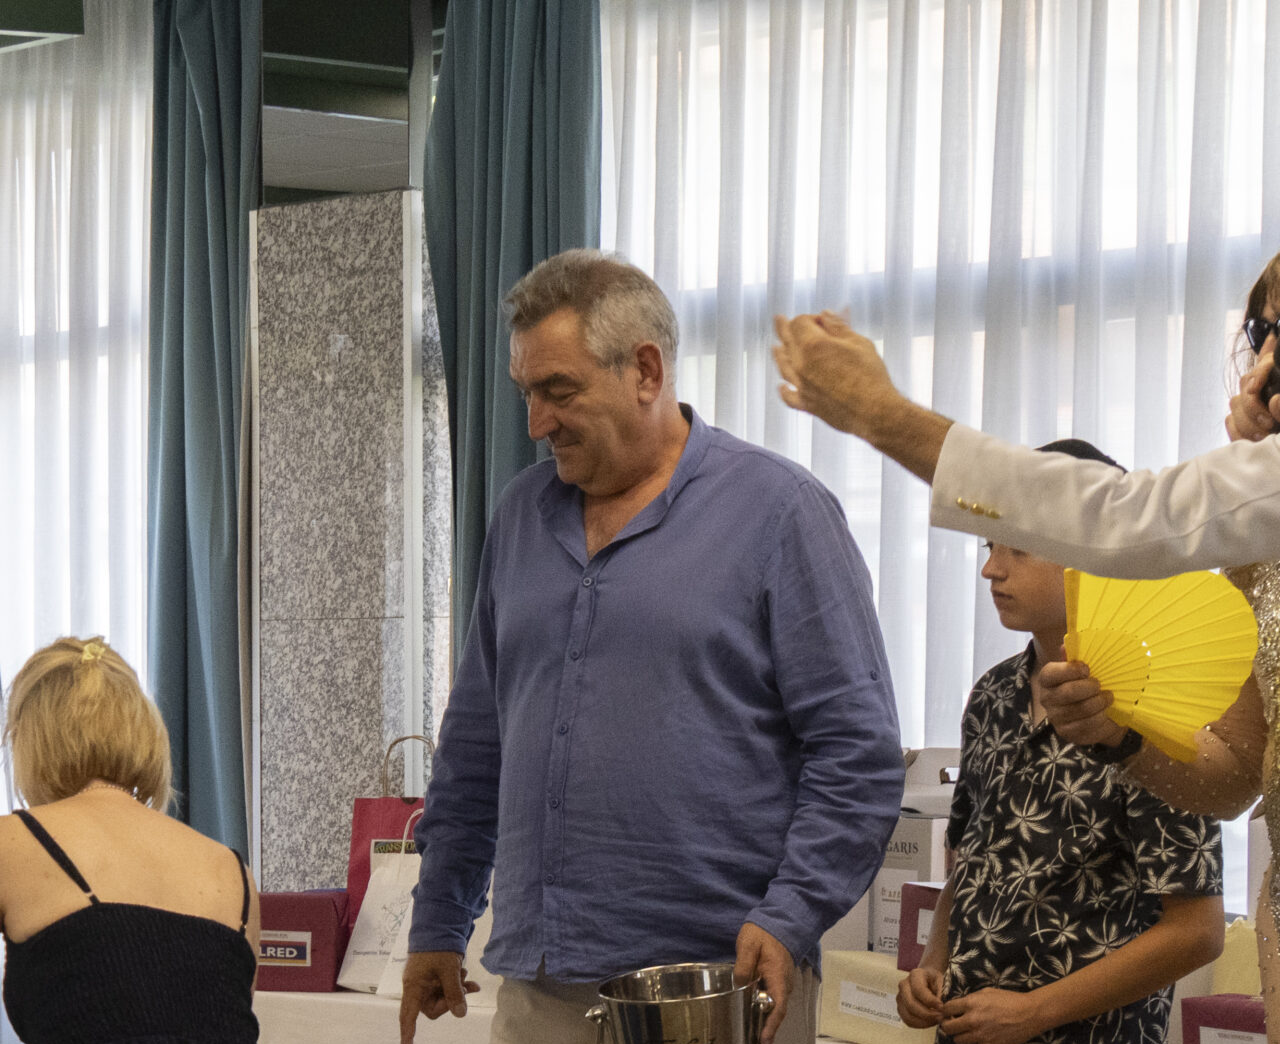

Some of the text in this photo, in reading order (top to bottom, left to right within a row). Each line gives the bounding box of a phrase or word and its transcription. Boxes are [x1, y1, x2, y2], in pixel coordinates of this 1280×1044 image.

[886, 841, 919, 855] GARIS
[877, 936, 899, 949] AFER
[258, 946, 298, 959] LRED
